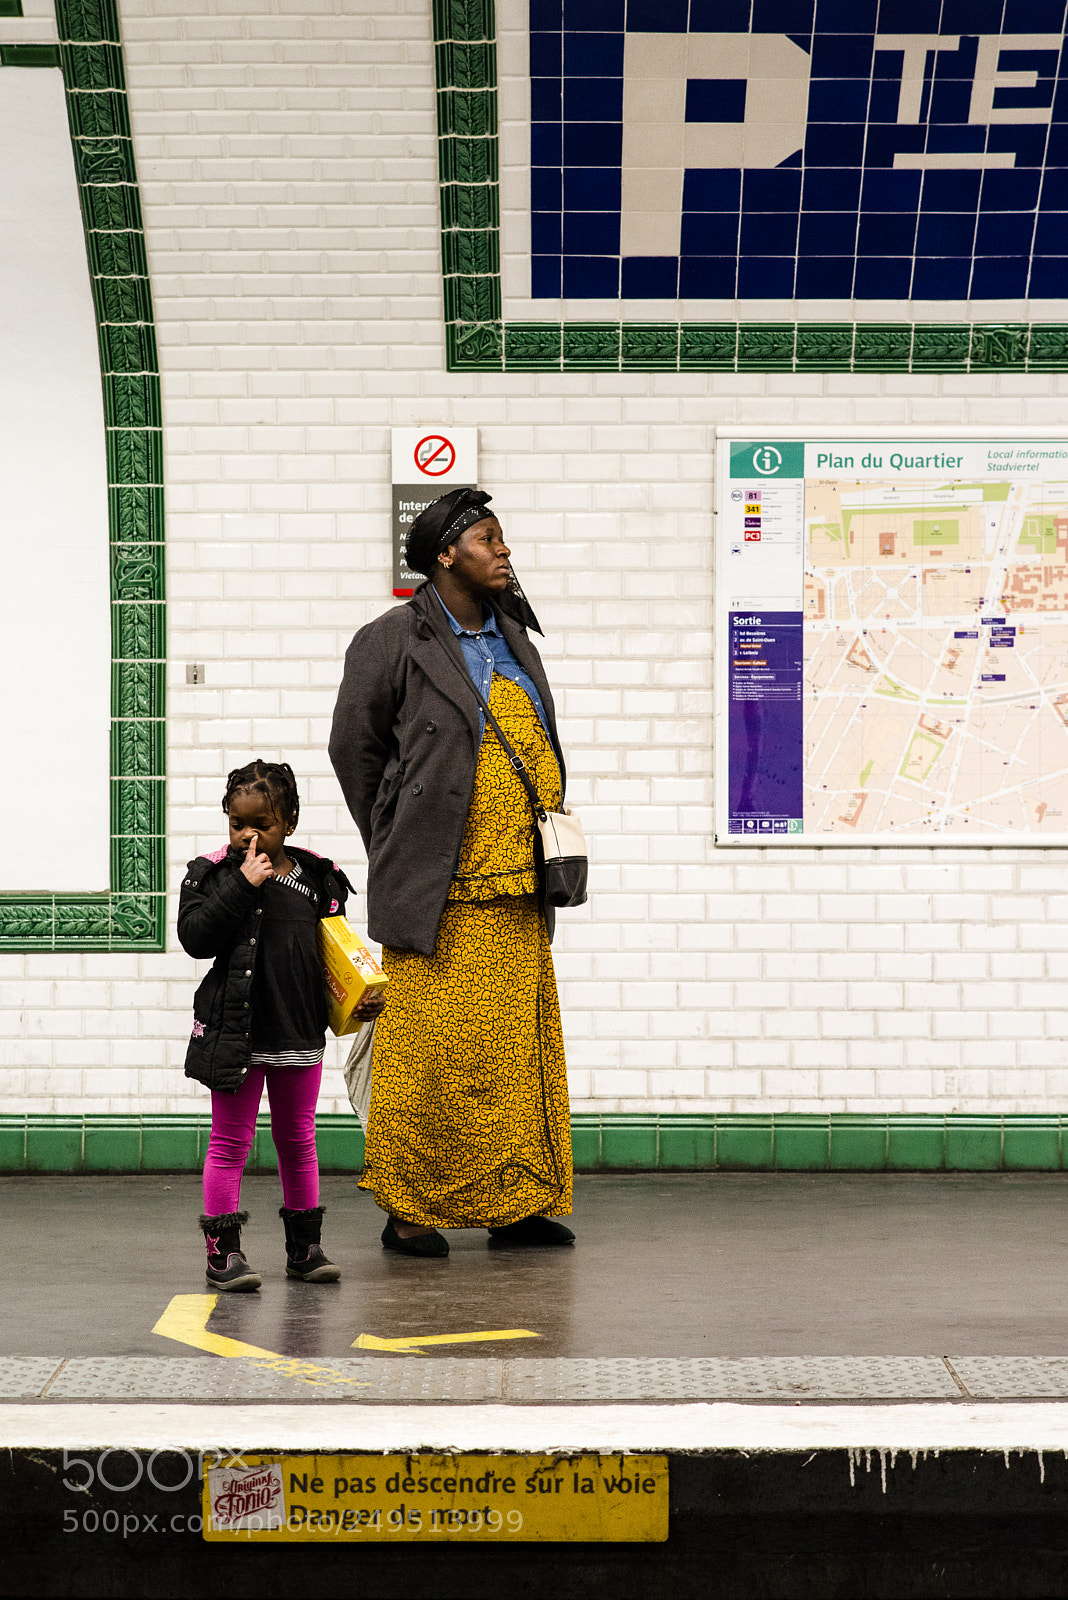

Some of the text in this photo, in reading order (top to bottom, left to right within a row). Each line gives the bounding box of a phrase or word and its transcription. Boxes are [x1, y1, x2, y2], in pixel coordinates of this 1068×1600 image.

[987, 450, 1068, 459] Local informatio
[817, 453, 964, 471] Plan du Quartier
[987, 462, 1040, 472] Stadviertel
[748, 492, 757, 500] 81
[746, 505, 760, 513] 341
[399, 512, 414, 523] de
[745, 532, 760, 540] PC3
[733, 616, 762, 625] Sortie
[289, 1471, 656, 1499] Ne pas descendre sur la voie
[290, 1503, 494, 1530] Danger de mort
